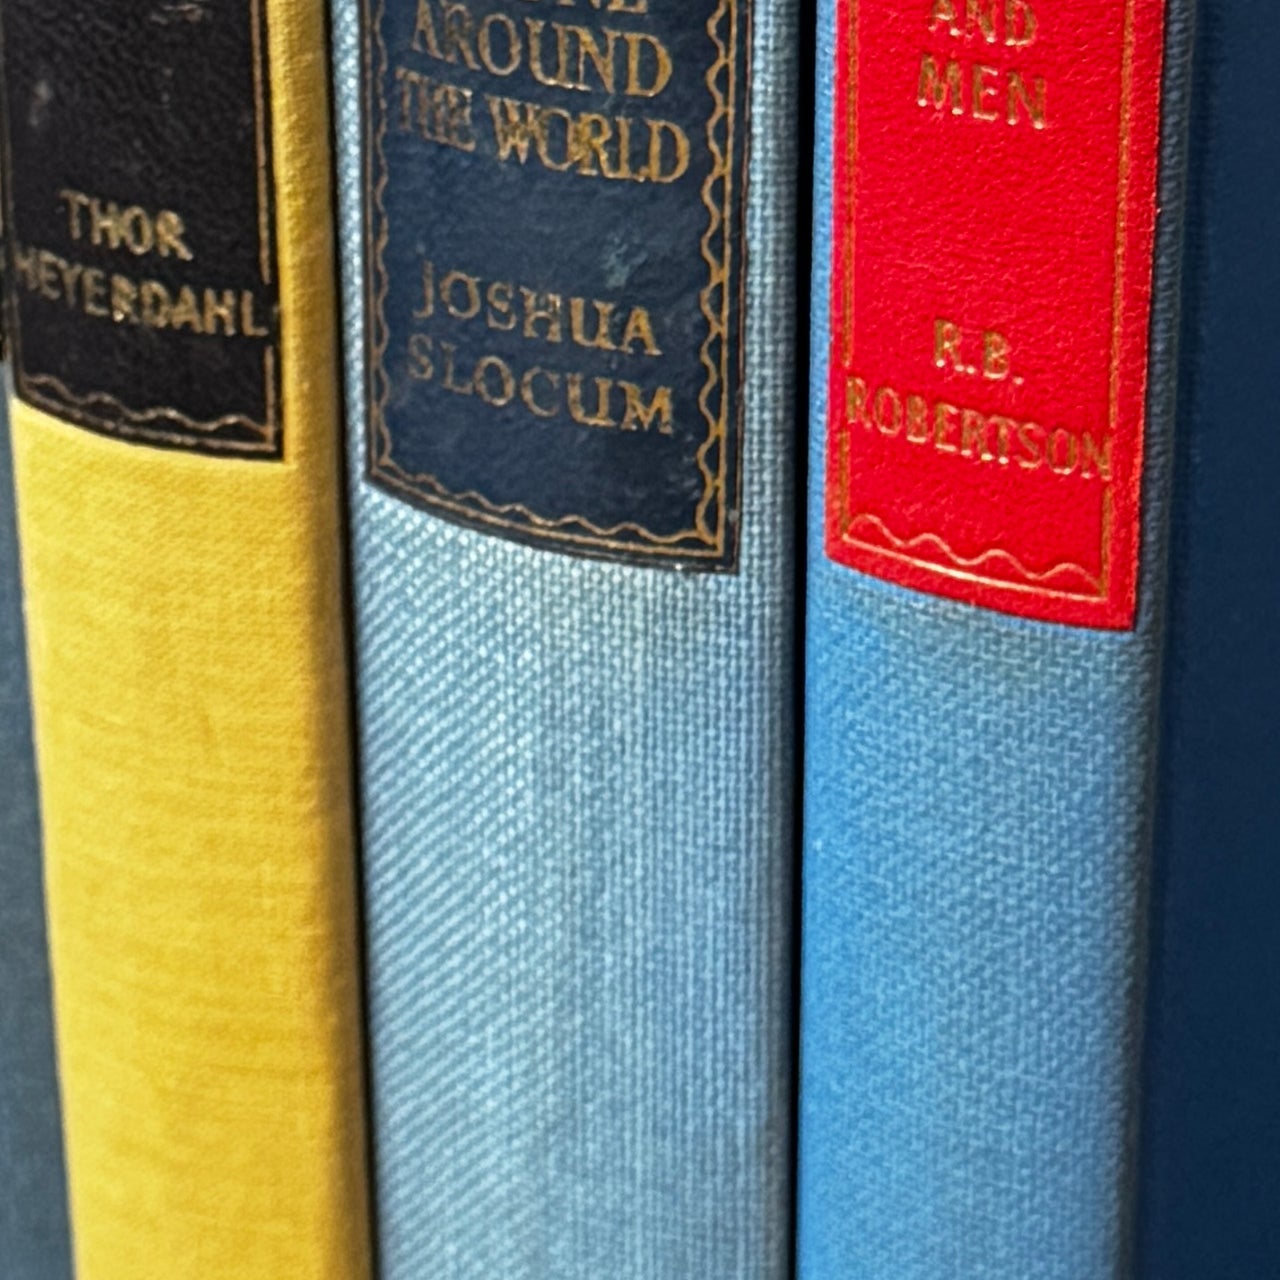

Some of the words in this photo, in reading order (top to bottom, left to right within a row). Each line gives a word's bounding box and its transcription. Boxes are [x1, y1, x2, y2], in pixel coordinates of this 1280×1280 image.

[395, 65, 477, 153] THE
[485, 93, 691, 184] WORLD
[917, 52, 1048, 131] MEN
[59, 189, 194, 261] THOR
[13, 246, 270, 337] HEYERDAHL
[412, 259, 663, 356] JOSHUA
[407, 333, 675, 435] SLOCUM
[933, 318, 1025, 385] R.B.
[846, 375, 1114, 481] ROBERTSON
